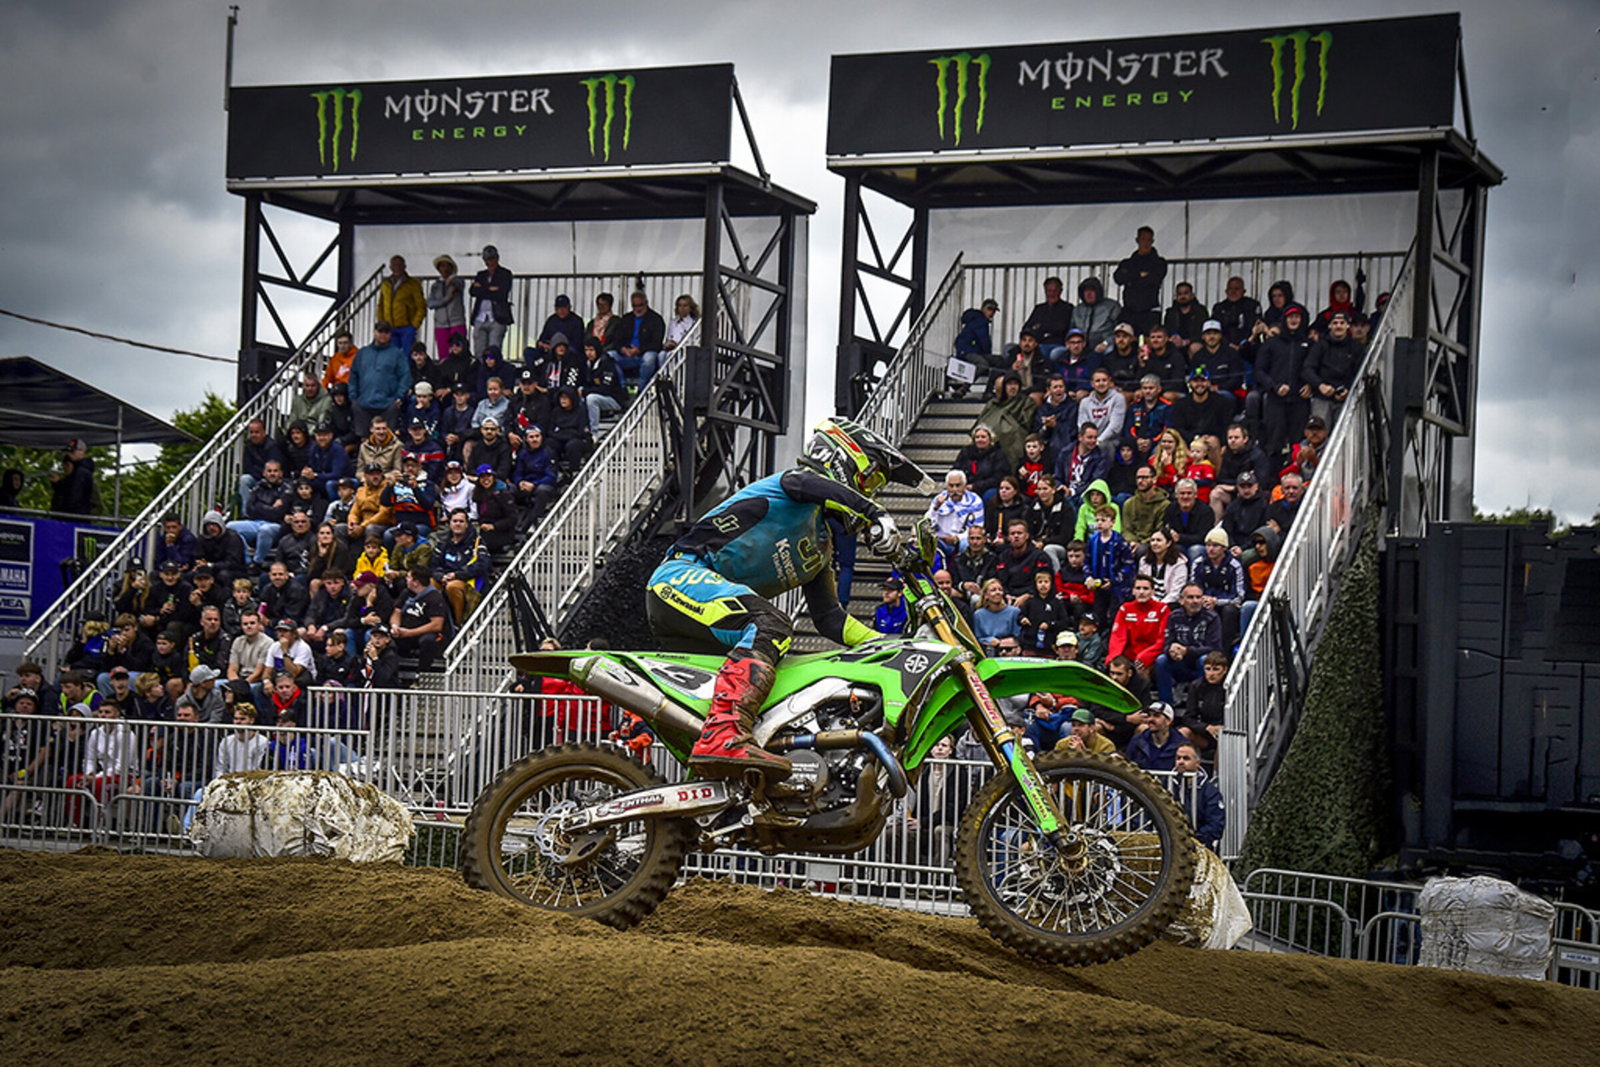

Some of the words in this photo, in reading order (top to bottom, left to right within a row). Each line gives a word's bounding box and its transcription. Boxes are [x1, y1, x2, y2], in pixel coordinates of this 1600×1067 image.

[1018, 48, 1229, 90] MONSTER
[384, 87, 555, 123] MONSTER
[1051, 89, 1194, 110] ENERGY
[412, 125, 527, 141] ENERGY
[671, 592, 705, 616] Kawasaki
